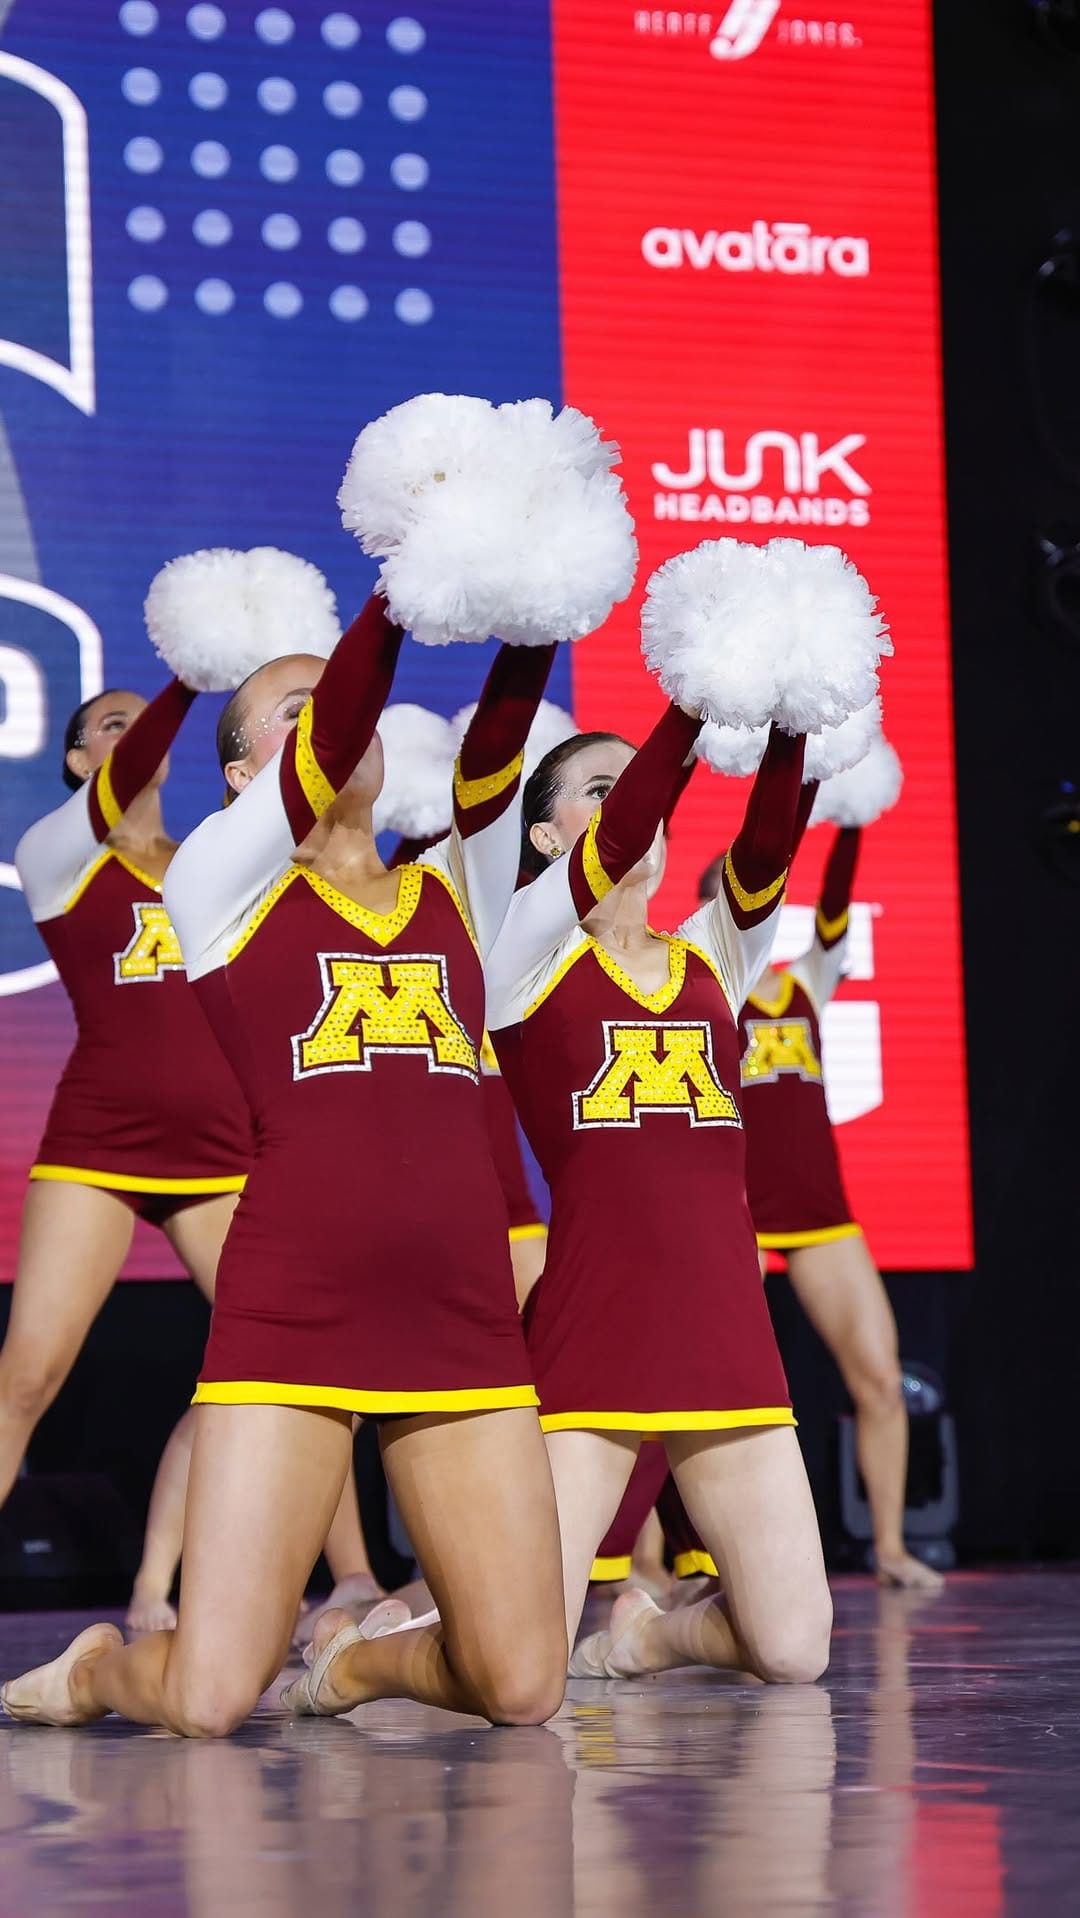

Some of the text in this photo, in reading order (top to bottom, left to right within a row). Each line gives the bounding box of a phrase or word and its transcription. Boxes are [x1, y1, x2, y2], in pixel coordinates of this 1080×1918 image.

[652, 428, 872, 496] JUNK
[654, 494, 870, 527] HEADBANDS
[291, 952, 480, 1085] M
[740, 1017, 823, 1087] M
[572, 1020, 743, 1130] M
